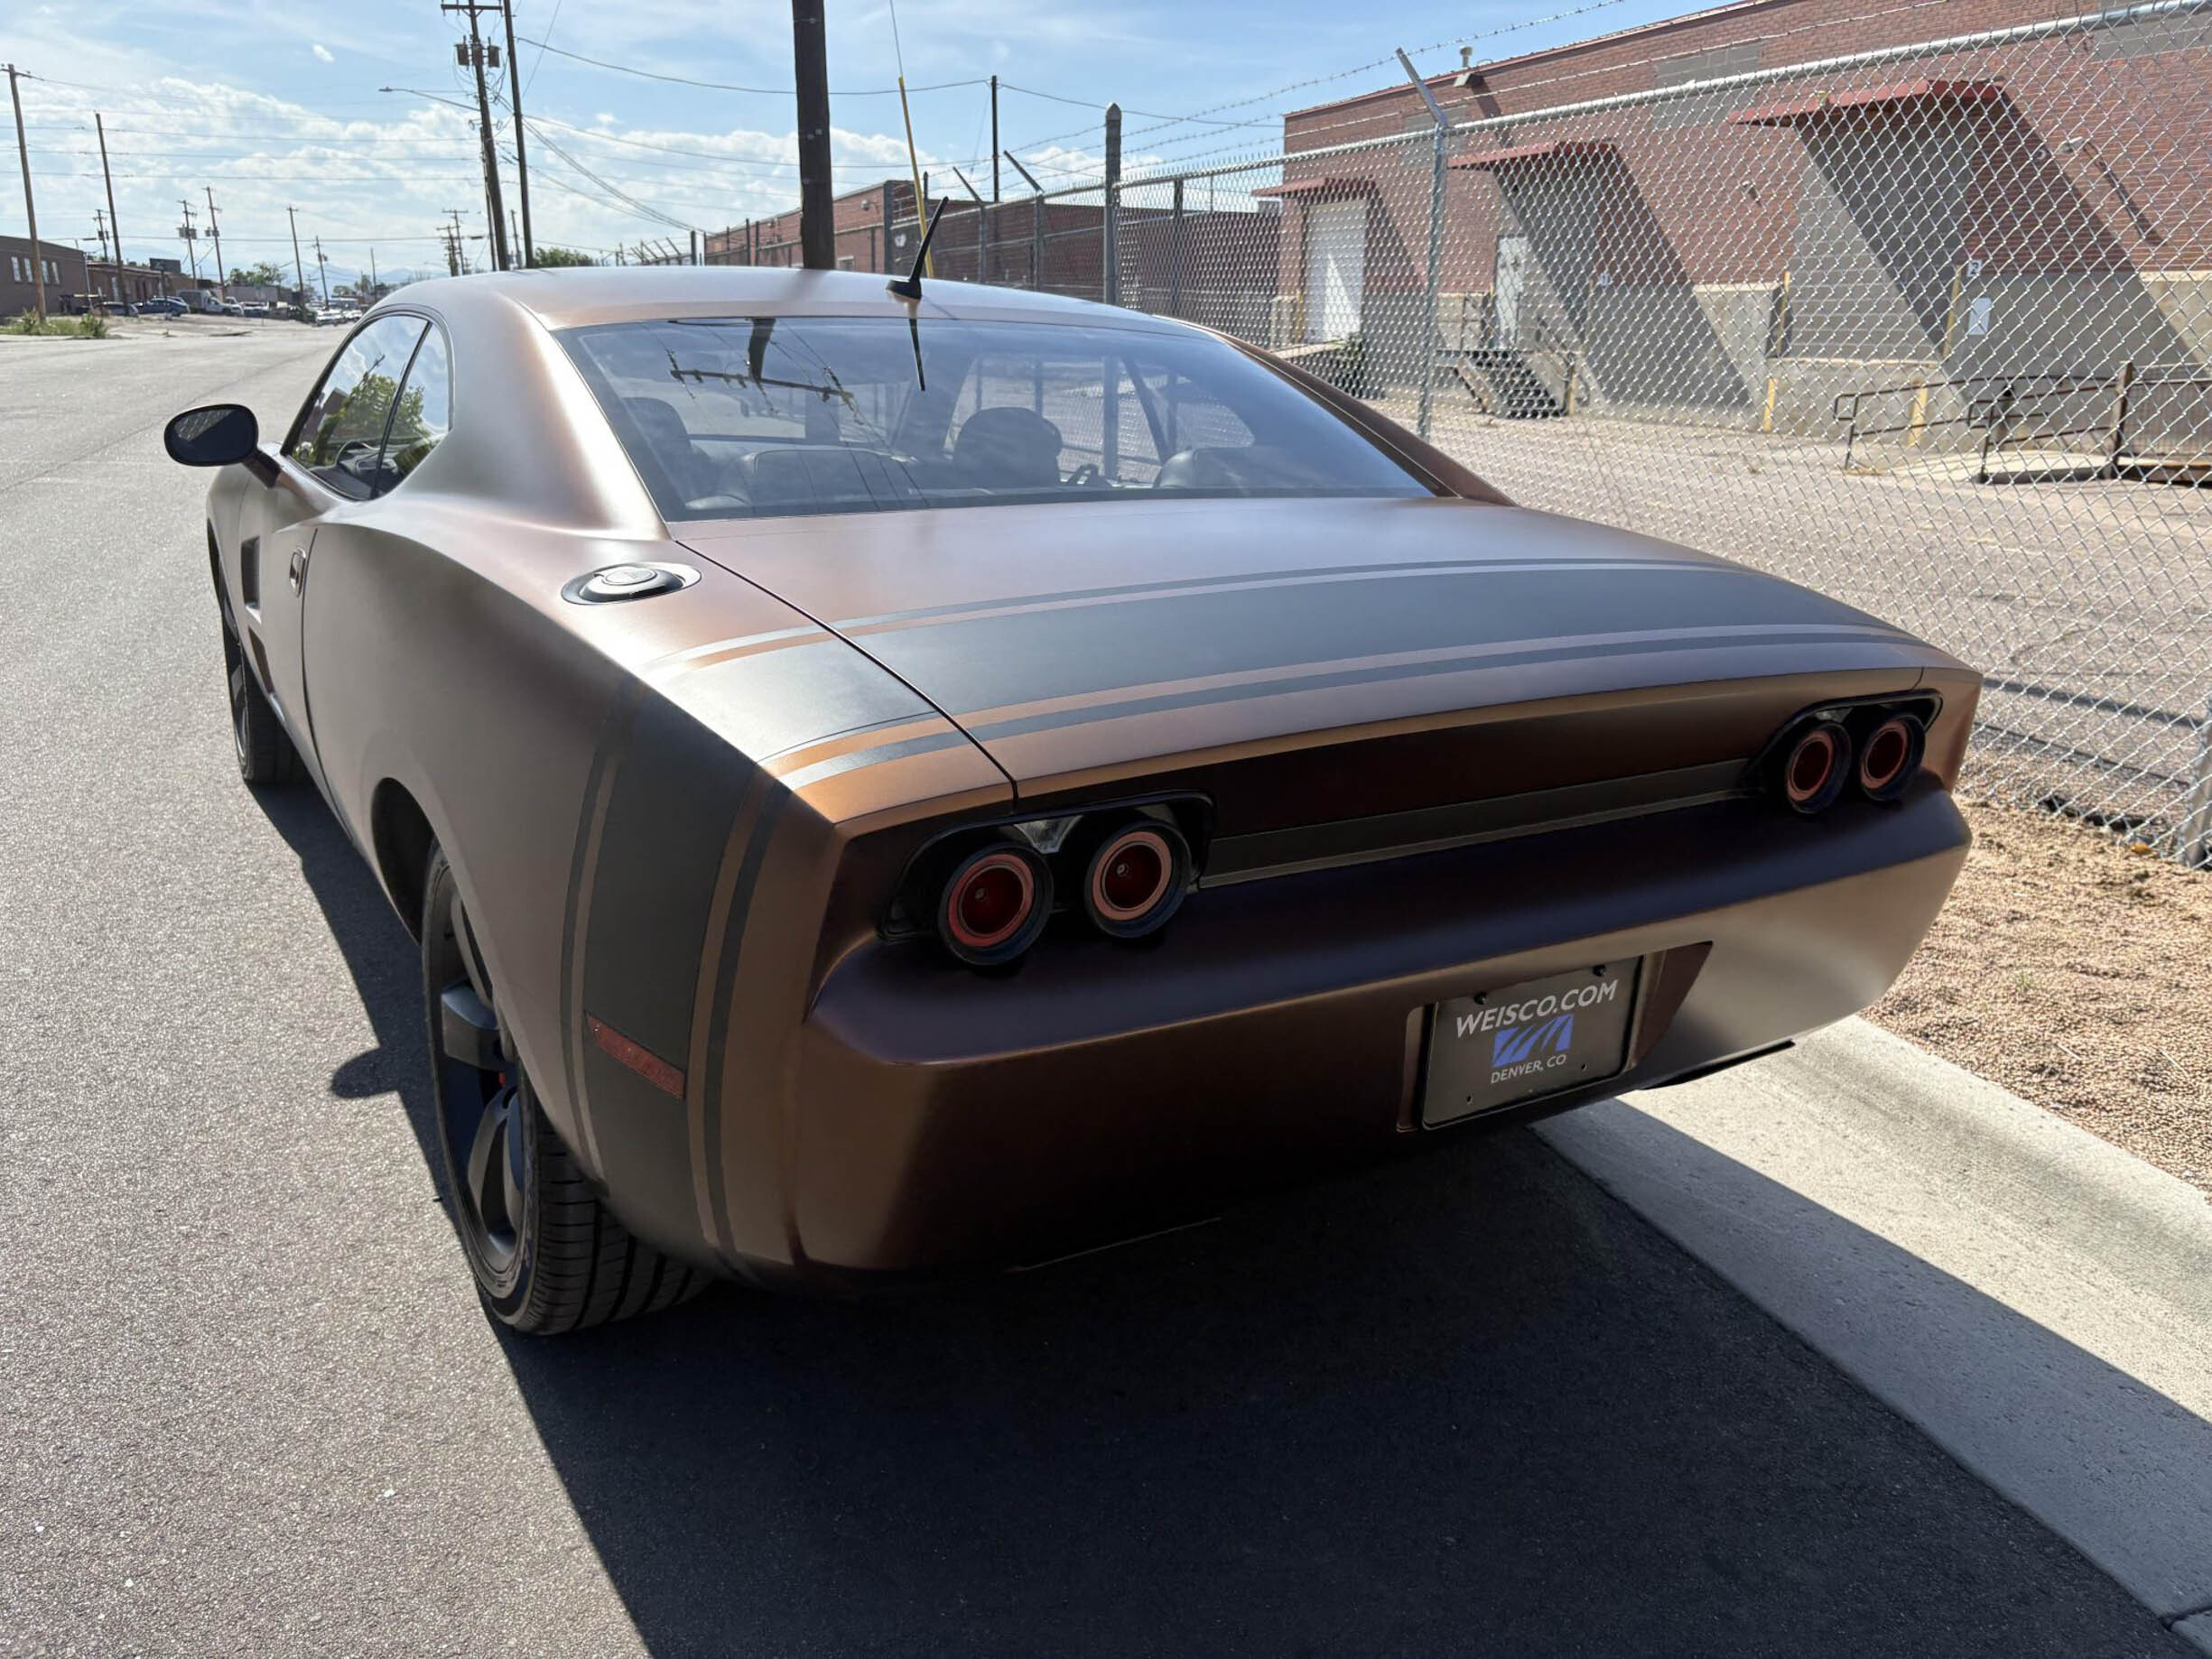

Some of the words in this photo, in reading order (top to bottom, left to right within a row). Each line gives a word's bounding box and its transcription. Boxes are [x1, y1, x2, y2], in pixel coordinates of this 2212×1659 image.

[1456, 979, 1618, 1038] WEISCO.COM
[1491, 1061, 1544, 1084] DENVER,
[1547, 1054, 1566, 1067] CO
